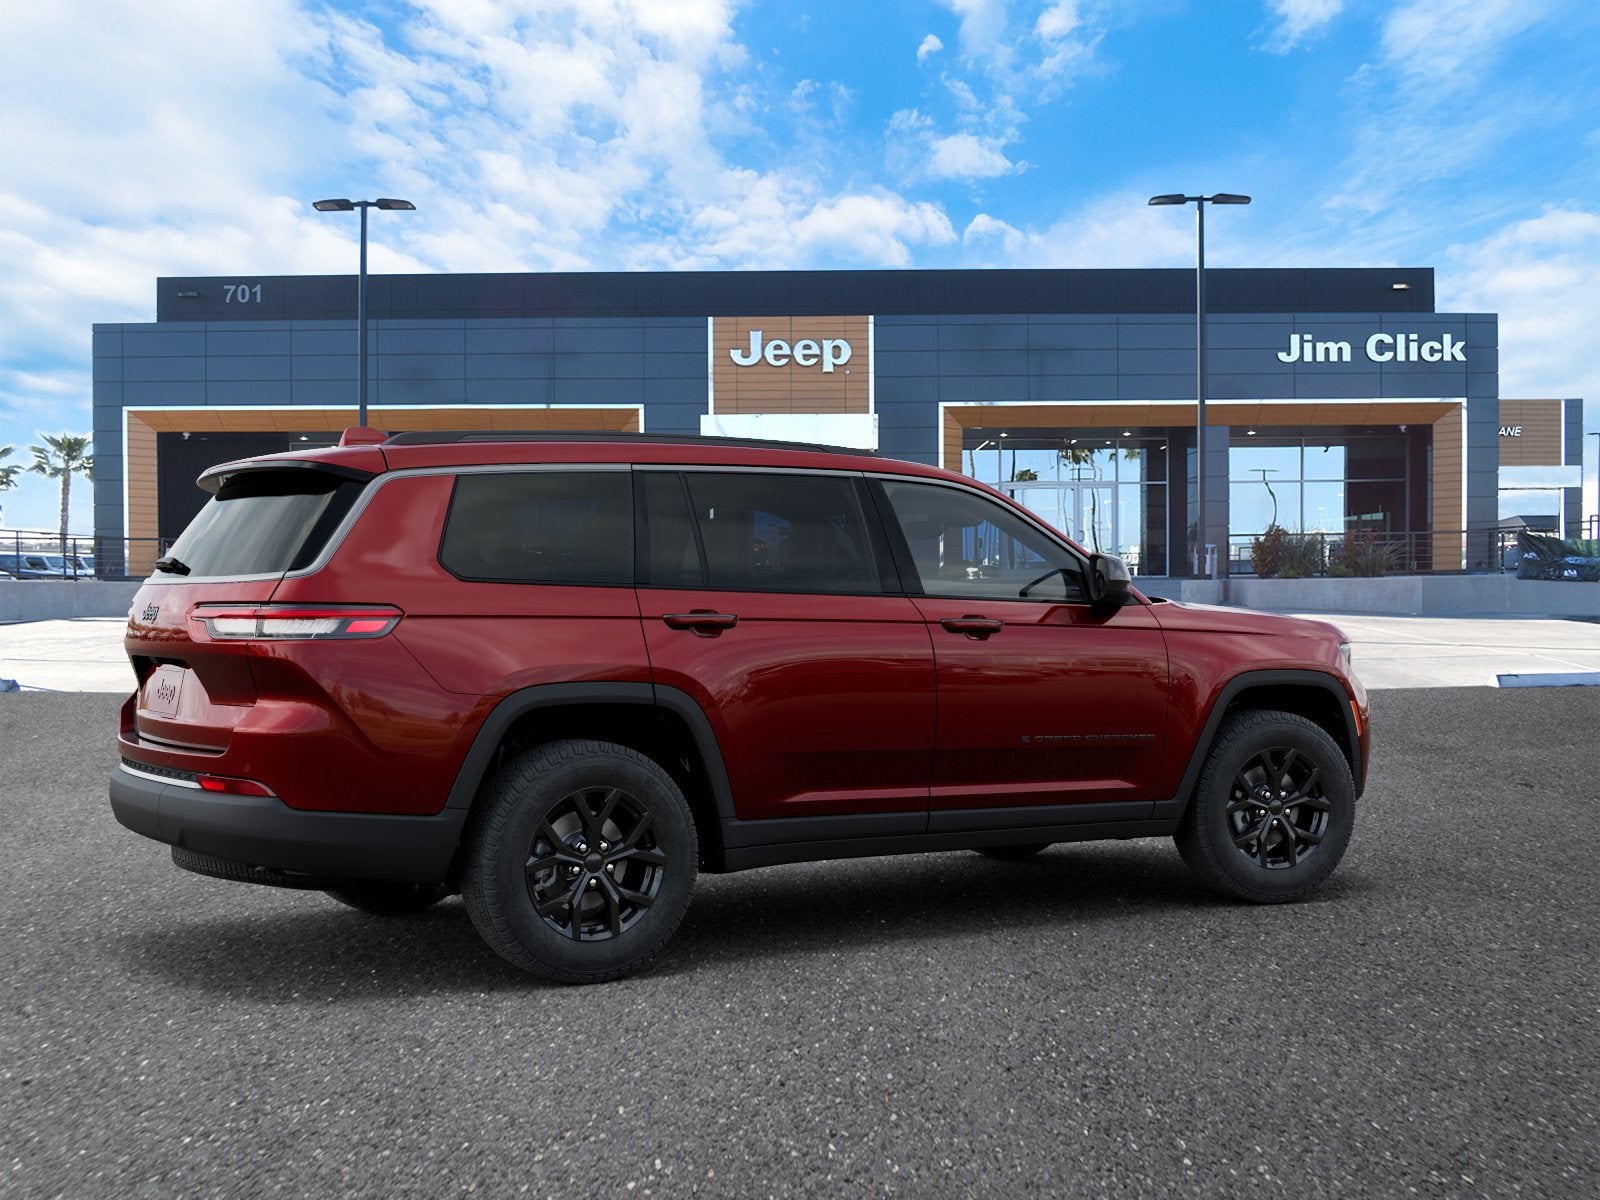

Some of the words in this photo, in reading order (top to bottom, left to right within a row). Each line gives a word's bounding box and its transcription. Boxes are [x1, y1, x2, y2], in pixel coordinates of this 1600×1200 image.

[223, 284, 262, 304] 701
[729, 330, 852, 374] Jeep
[1277, 333, 1352, 363] Jim
[1366, 333, 1467, 363] Click
[1498, 426, 1522, 437] ANE
